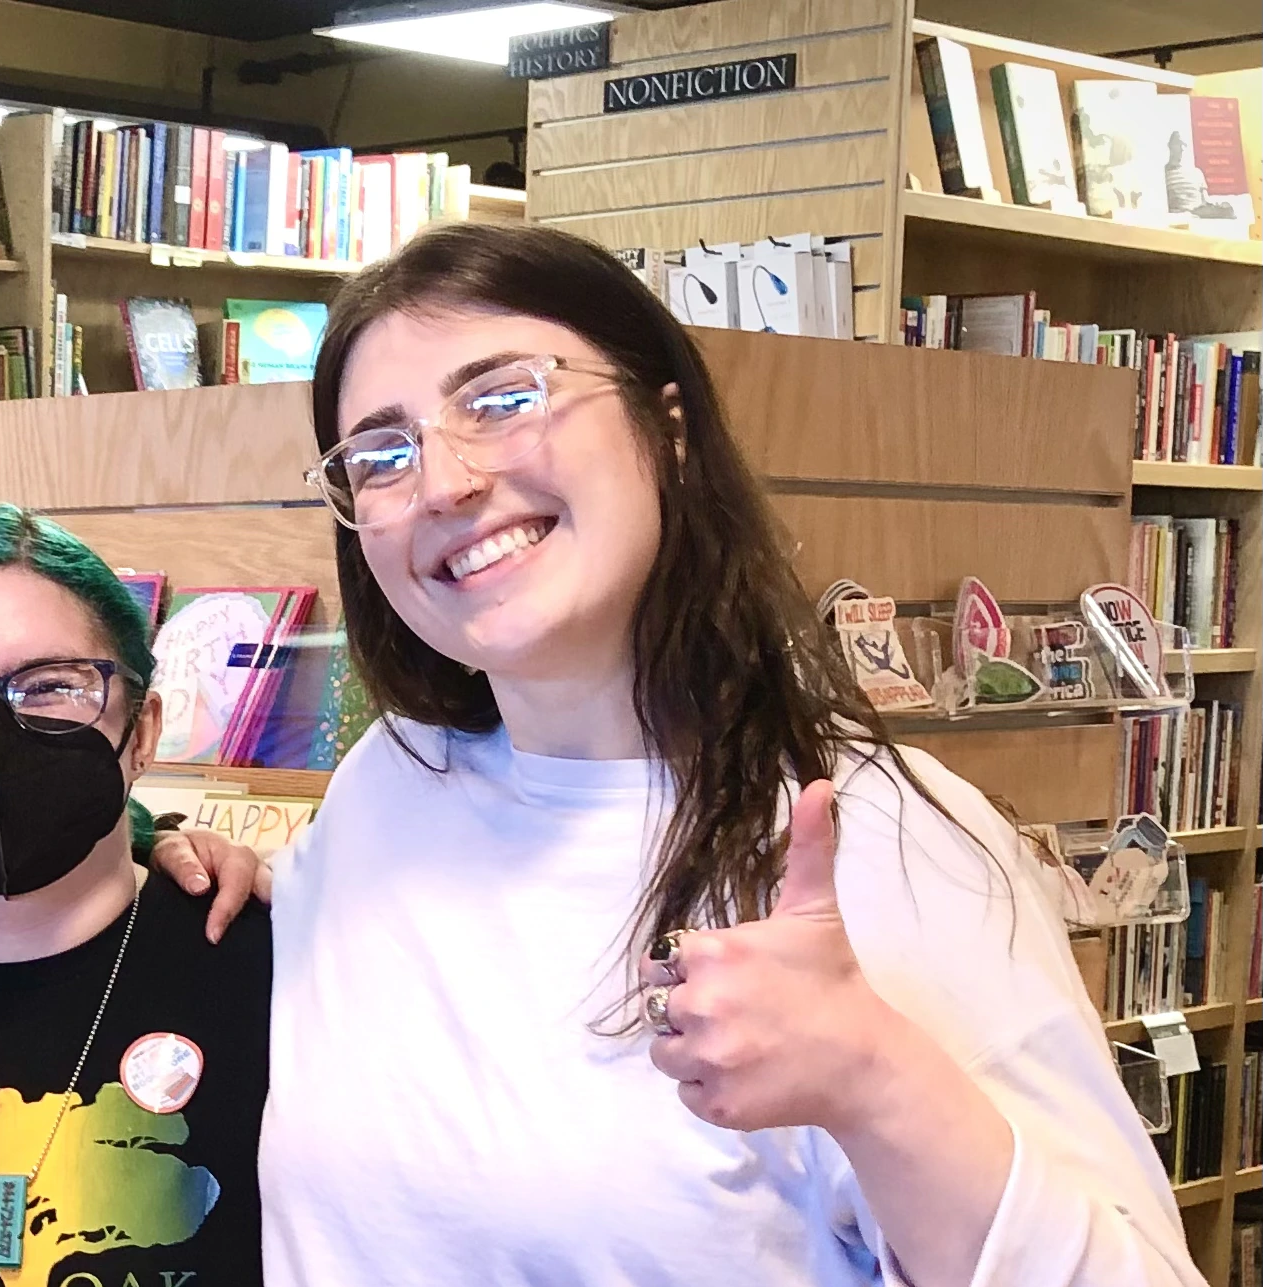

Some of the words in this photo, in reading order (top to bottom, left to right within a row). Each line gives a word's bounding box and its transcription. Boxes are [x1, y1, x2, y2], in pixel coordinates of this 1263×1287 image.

[512, 22, 600, 52] POLITICS
[509, 47, 599, 78] HISTORY
[608, 57, 788, 108] NONFICTION
[144, 332, 195, 353] CELLS
[166, 604, 231, 650] HAPPY
[868, 602, 893, 622] SLEEP
[194, 803, 310, 847] HAPPY
